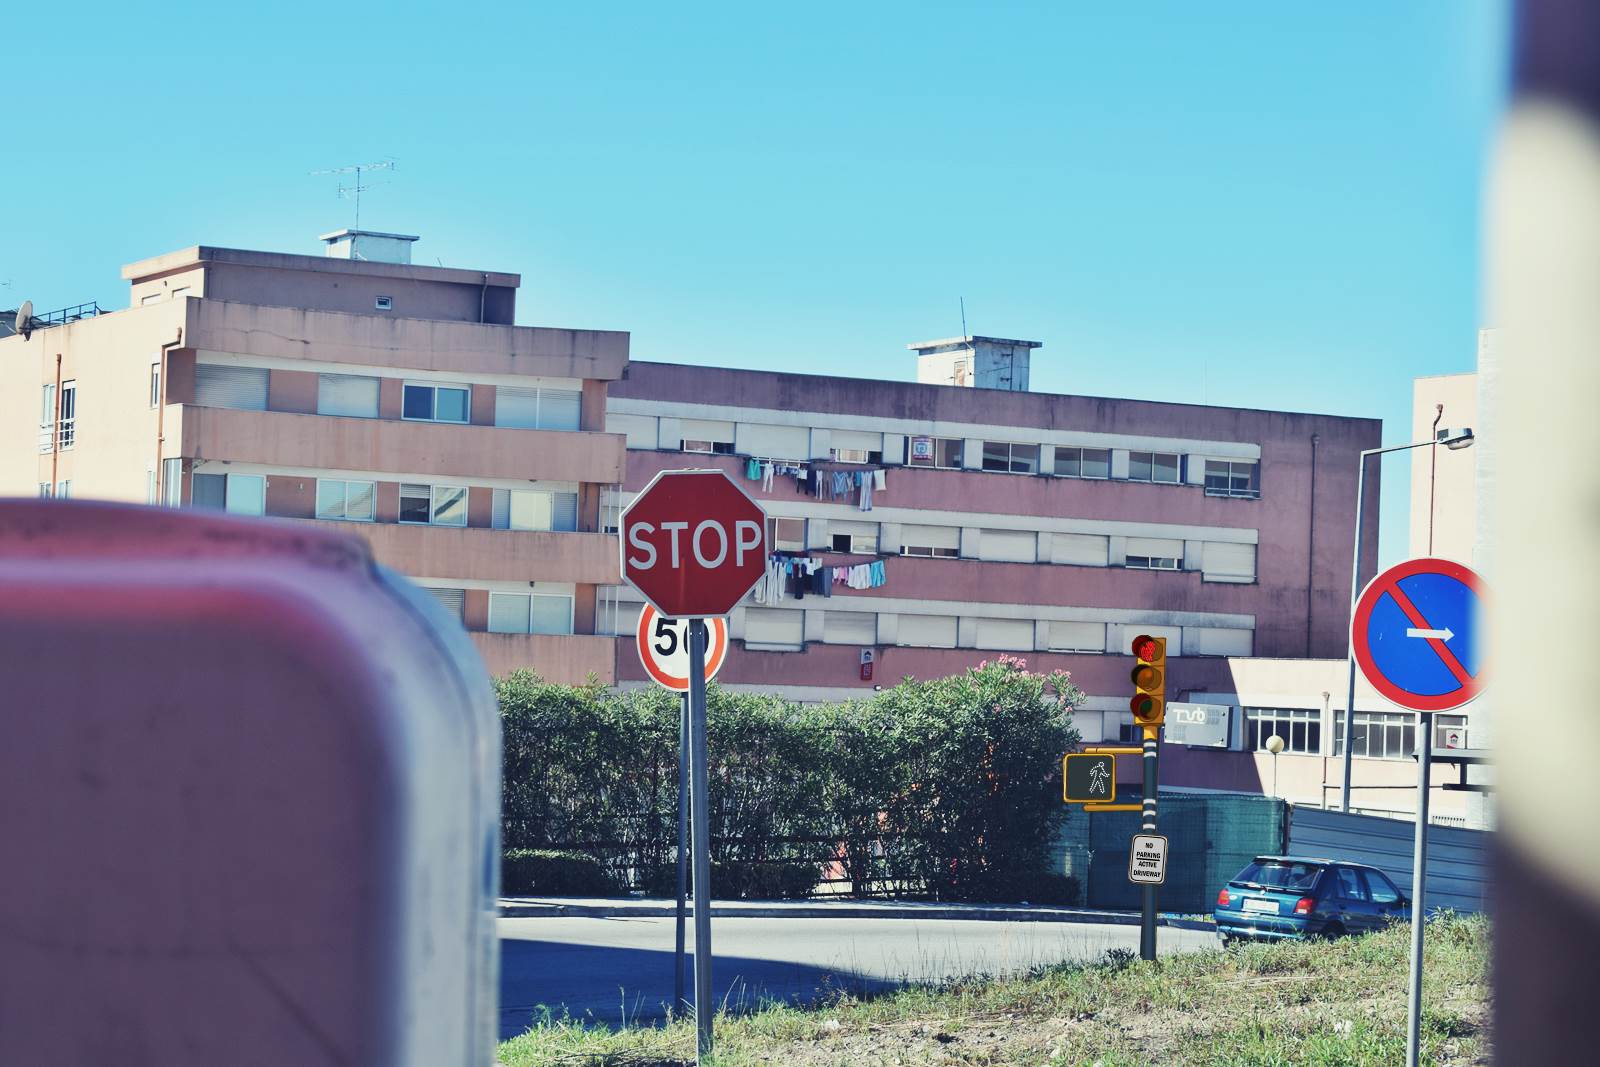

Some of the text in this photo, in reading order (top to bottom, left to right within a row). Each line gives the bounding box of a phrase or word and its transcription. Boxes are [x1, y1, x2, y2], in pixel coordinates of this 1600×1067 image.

[628, 519, 762, 570] STOP
[1136, 851, 1161, 859] PARKING
[1133, 869, 1161, 878] DRIVEWAY
